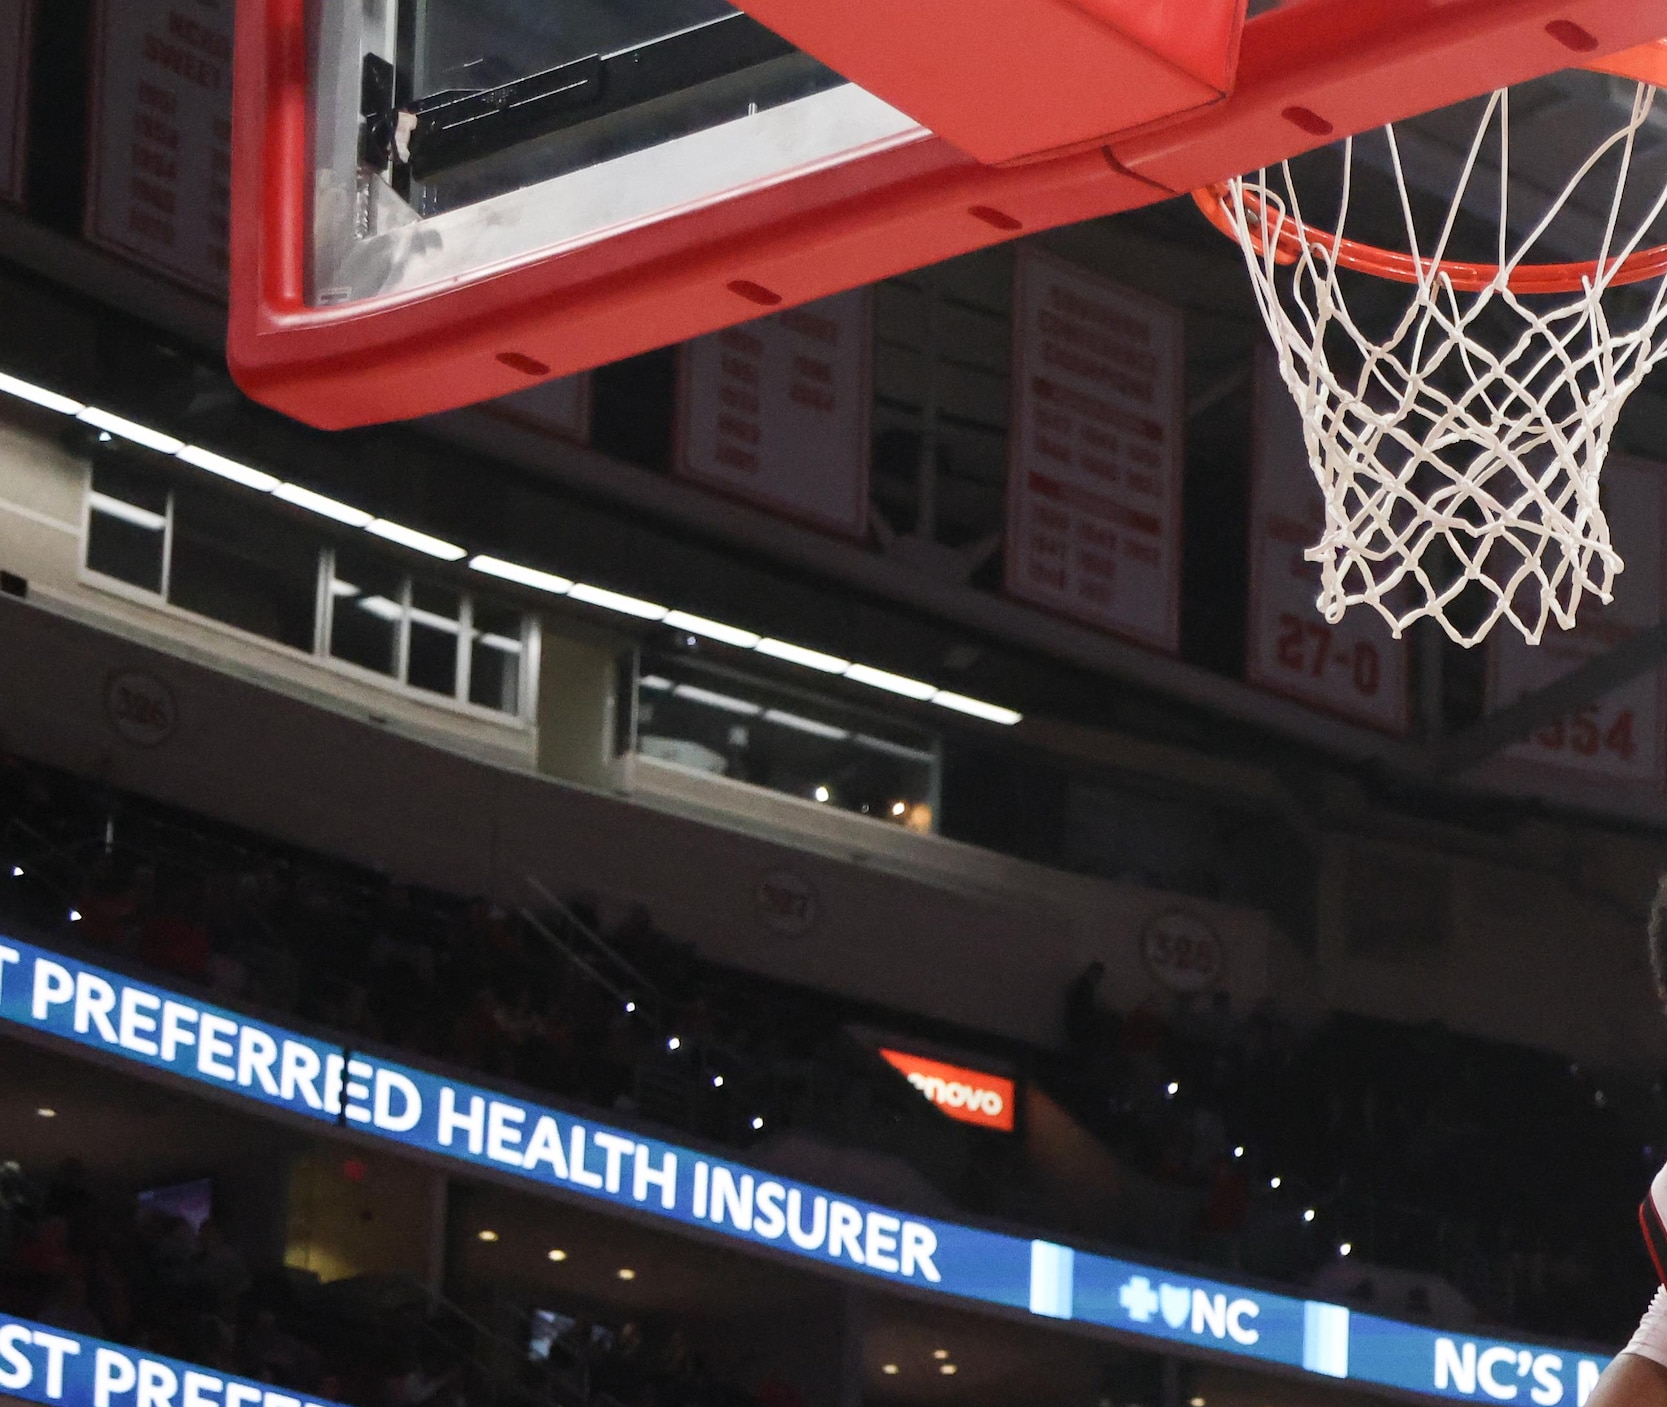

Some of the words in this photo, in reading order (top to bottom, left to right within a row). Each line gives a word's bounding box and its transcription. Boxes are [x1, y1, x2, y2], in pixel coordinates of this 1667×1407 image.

[1277, 612, 1380, 696] 27-0
[1530, 704, 1637, 760] 954
[32, 959, 421, 1131] PREFERRED
[438, 1087, 677, 1208] HEALTH
[693, 1162, 941, 1282] INSURER
[905, 1070, 1002, 1117] enovo
[1192, 1283, 1262, 1346] NC
